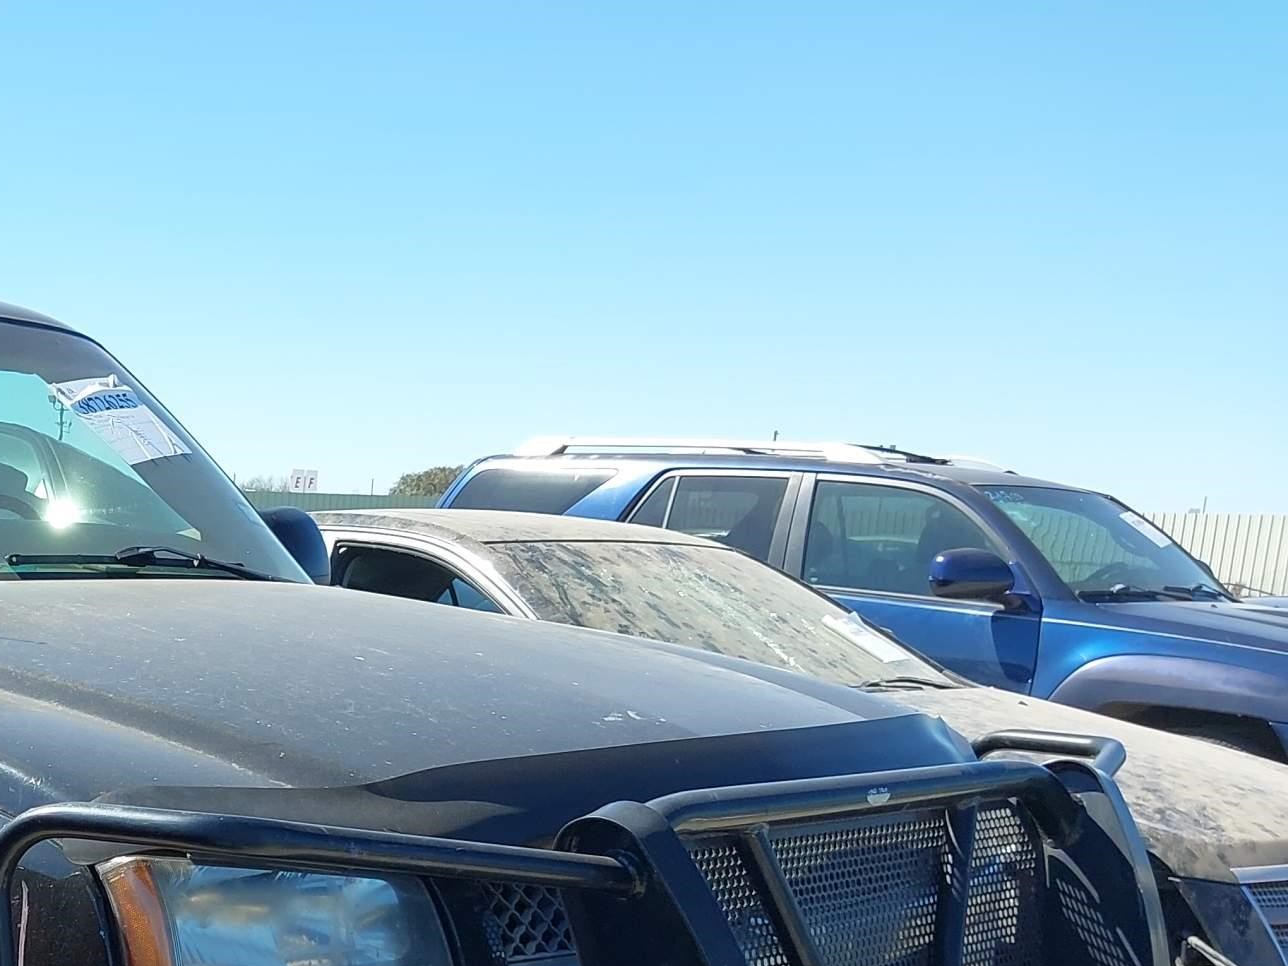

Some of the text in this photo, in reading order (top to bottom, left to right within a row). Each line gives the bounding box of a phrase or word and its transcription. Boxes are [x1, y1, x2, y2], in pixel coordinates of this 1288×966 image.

[76, 392, 139, 415] 38726255
[294, 476, 302, 489] E
[307, 477, 315, 489] F
